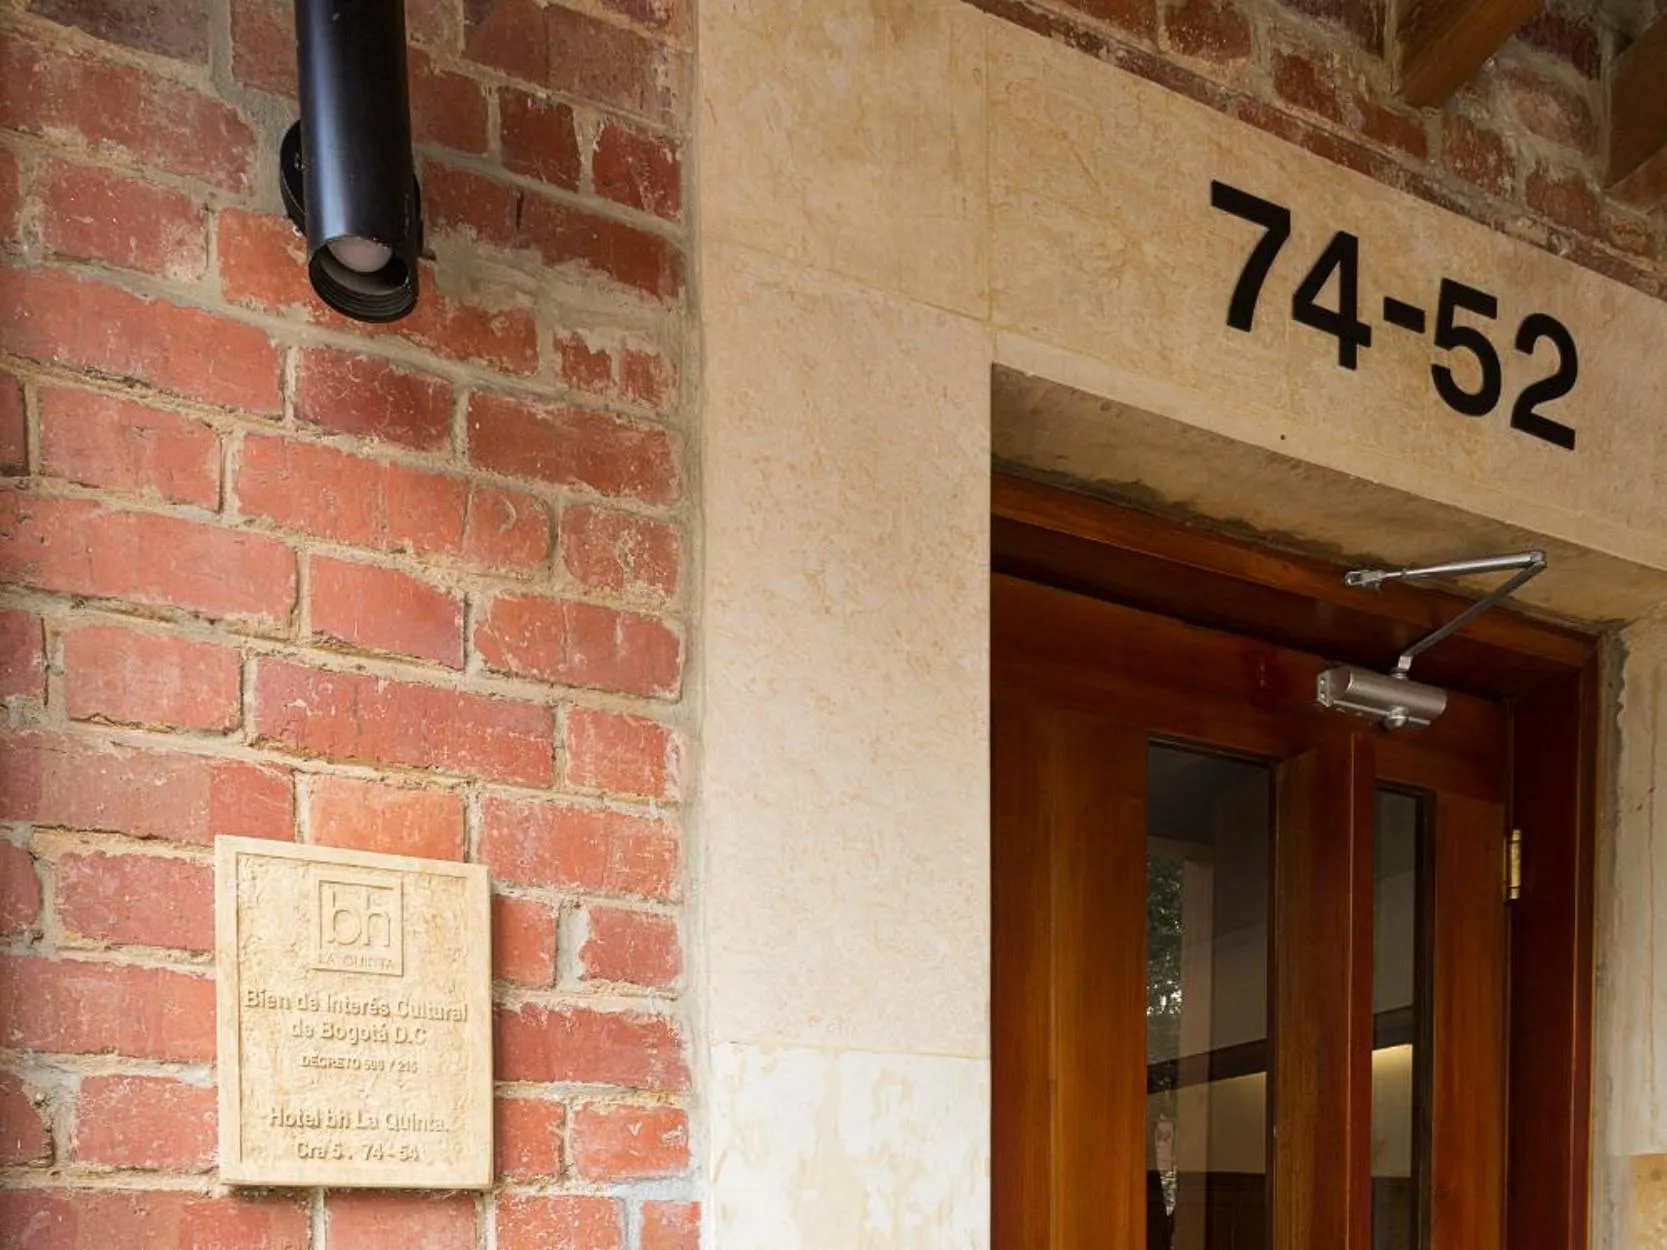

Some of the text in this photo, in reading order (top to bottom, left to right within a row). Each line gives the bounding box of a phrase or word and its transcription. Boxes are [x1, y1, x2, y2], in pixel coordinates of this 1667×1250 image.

[1211, 180, 1578, 450] 74-52
[244, 988, 469, 1023] Bien de Interés Cultural
[291, 1019, 314, 1040] de
[320, 1021, 389, 1046] Bogotá
[269, 1106, 321, 1129] Hotel
[355, 1111, 380, 1131] La
